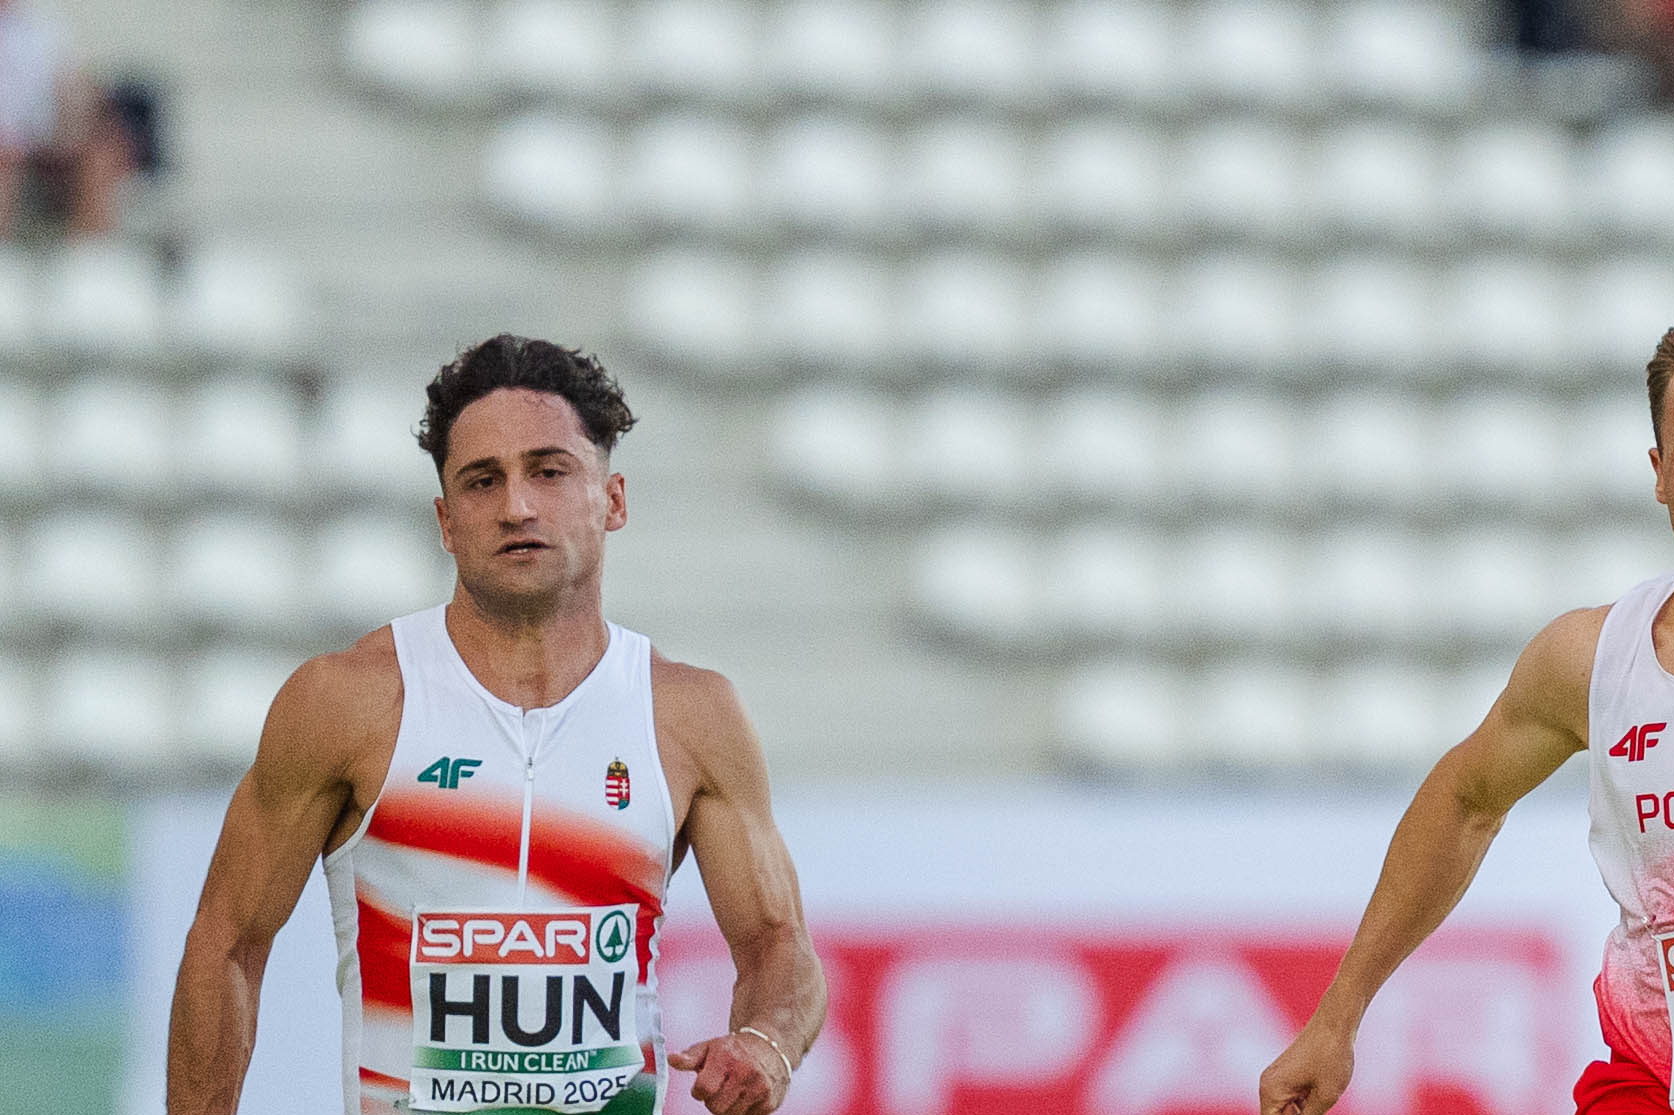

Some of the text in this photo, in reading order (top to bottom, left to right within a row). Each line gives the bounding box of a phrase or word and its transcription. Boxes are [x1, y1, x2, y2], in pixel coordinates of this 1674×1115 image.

[1608, 721, 1668, 762] 4F
[417, 756, 483, 790] 4F
[421, 918, 587, 960] SPAR
[429, 971, 626, 1047] HUN
[460, 1051, 467, 1069] I
[471, 1051, 519, 1071] RUN
[431, 1077, 556, 1105] MADRID
